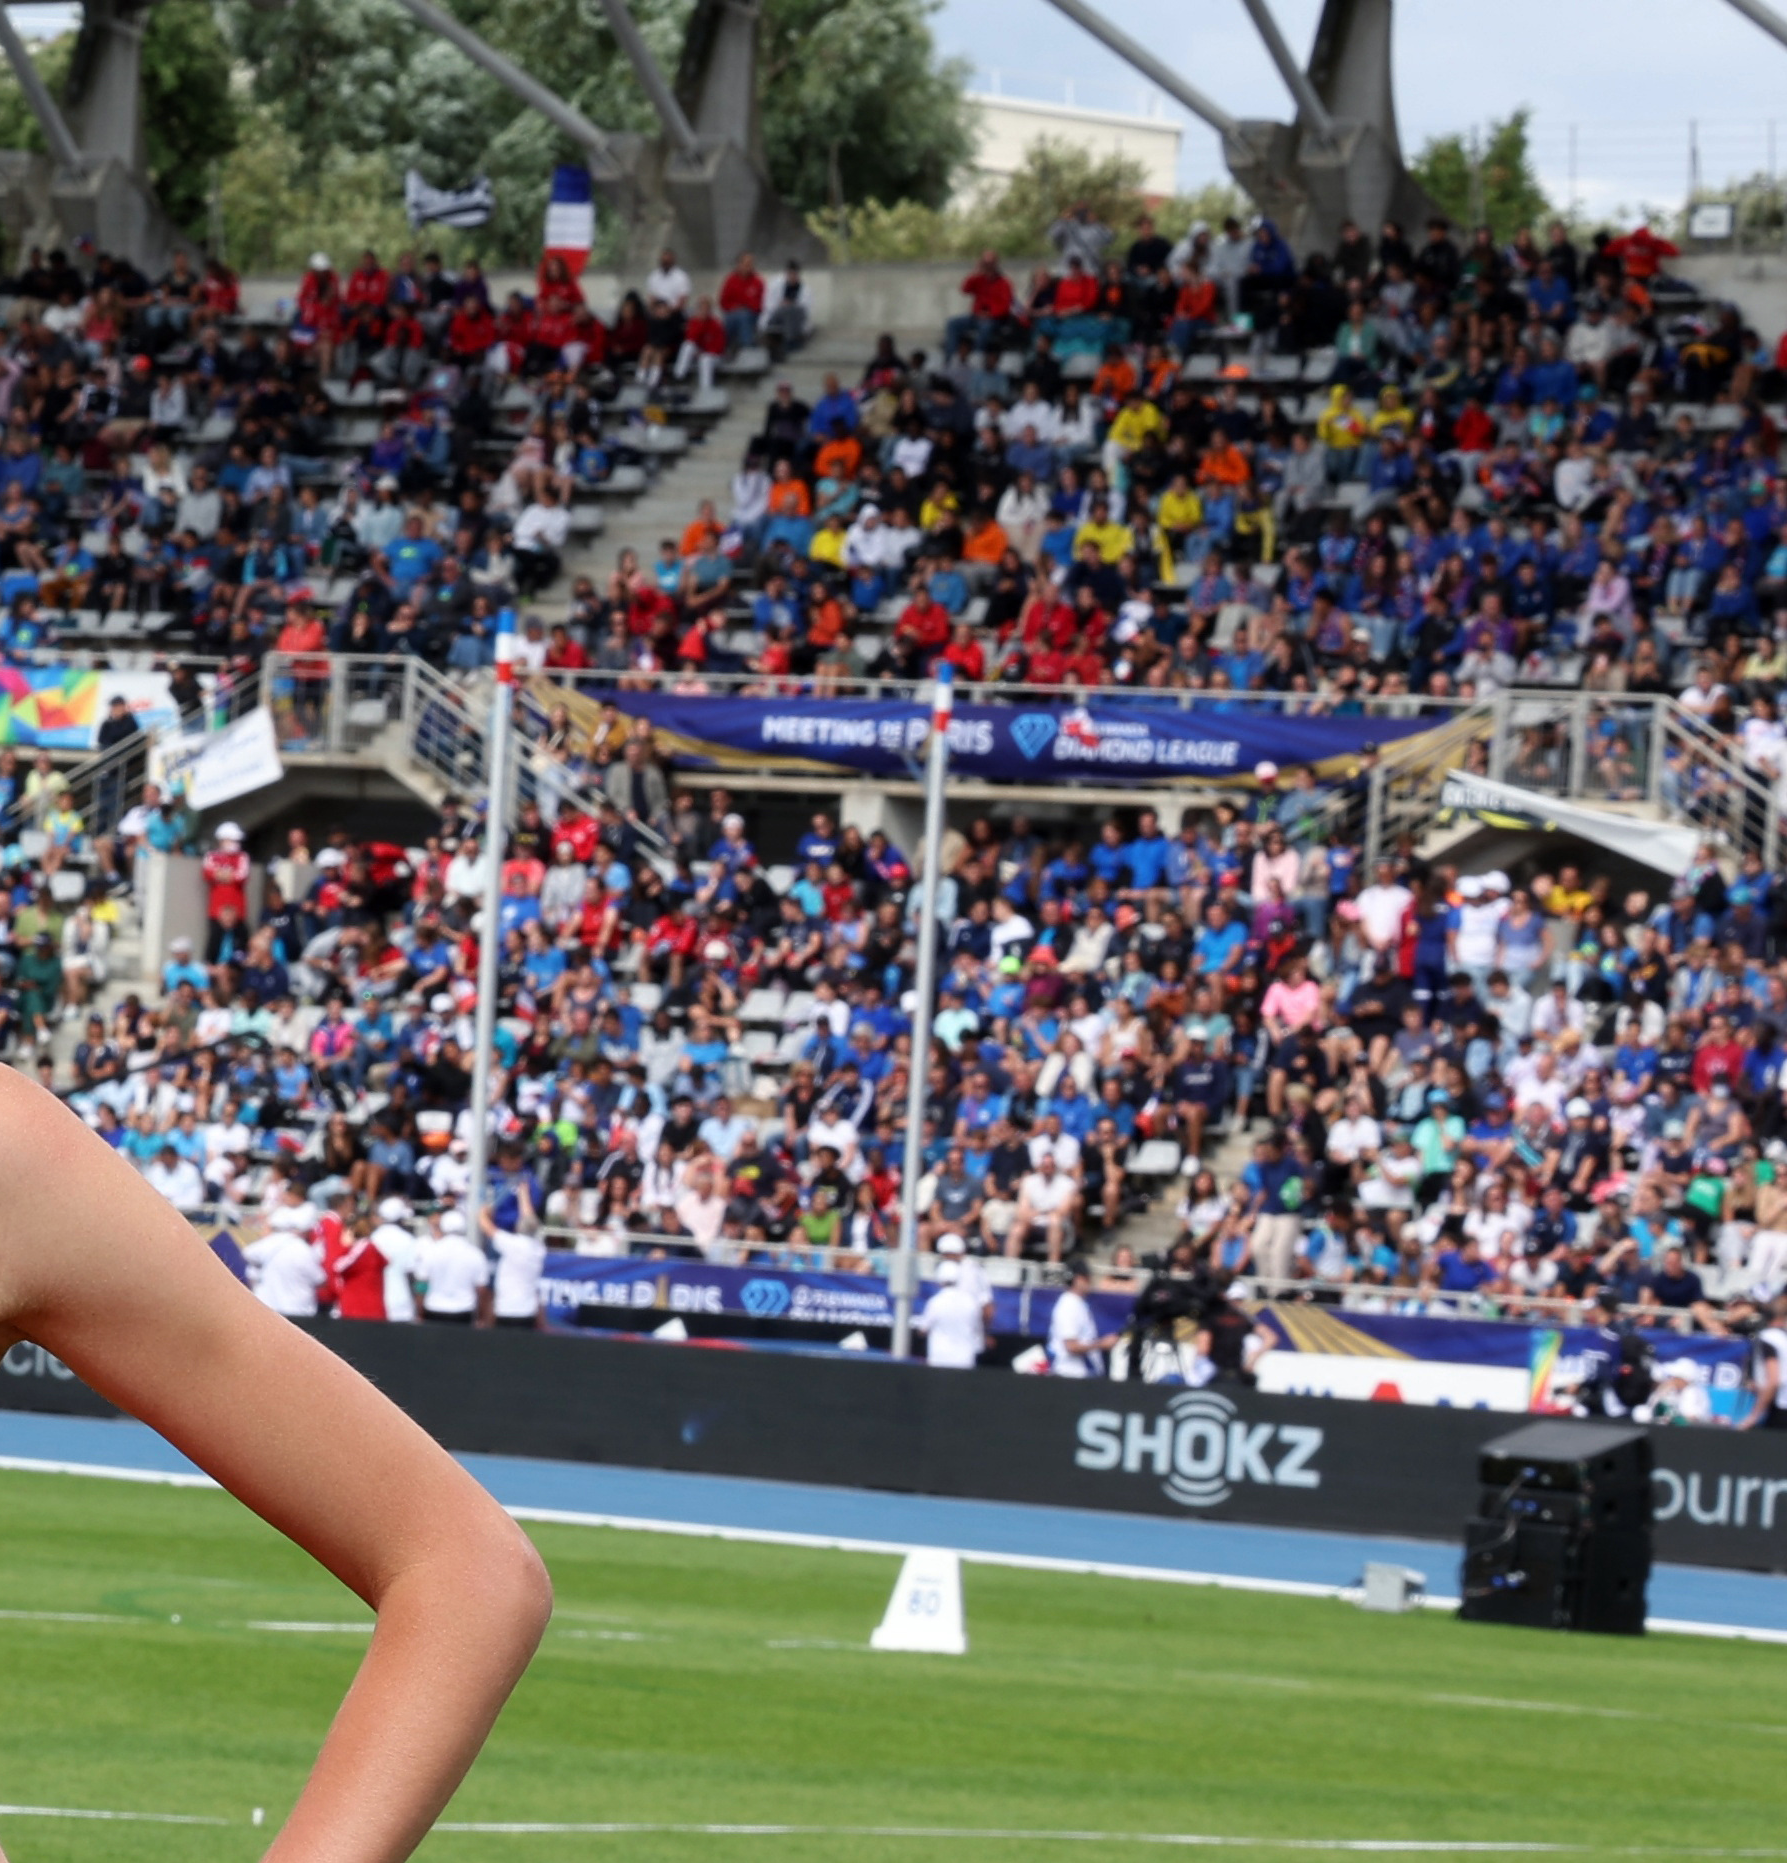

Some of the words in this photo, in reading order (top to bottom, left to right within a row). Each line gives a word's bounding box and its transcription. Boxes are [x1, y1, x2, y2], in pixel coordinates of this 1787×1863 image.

[762, 715, 876, 746] MEETING
[906, 717, 994, 757] PRIS
[1155, 739, 1239, 767] LEAGUE
[1075, 1409, 1323, 1489] SHOKZ
